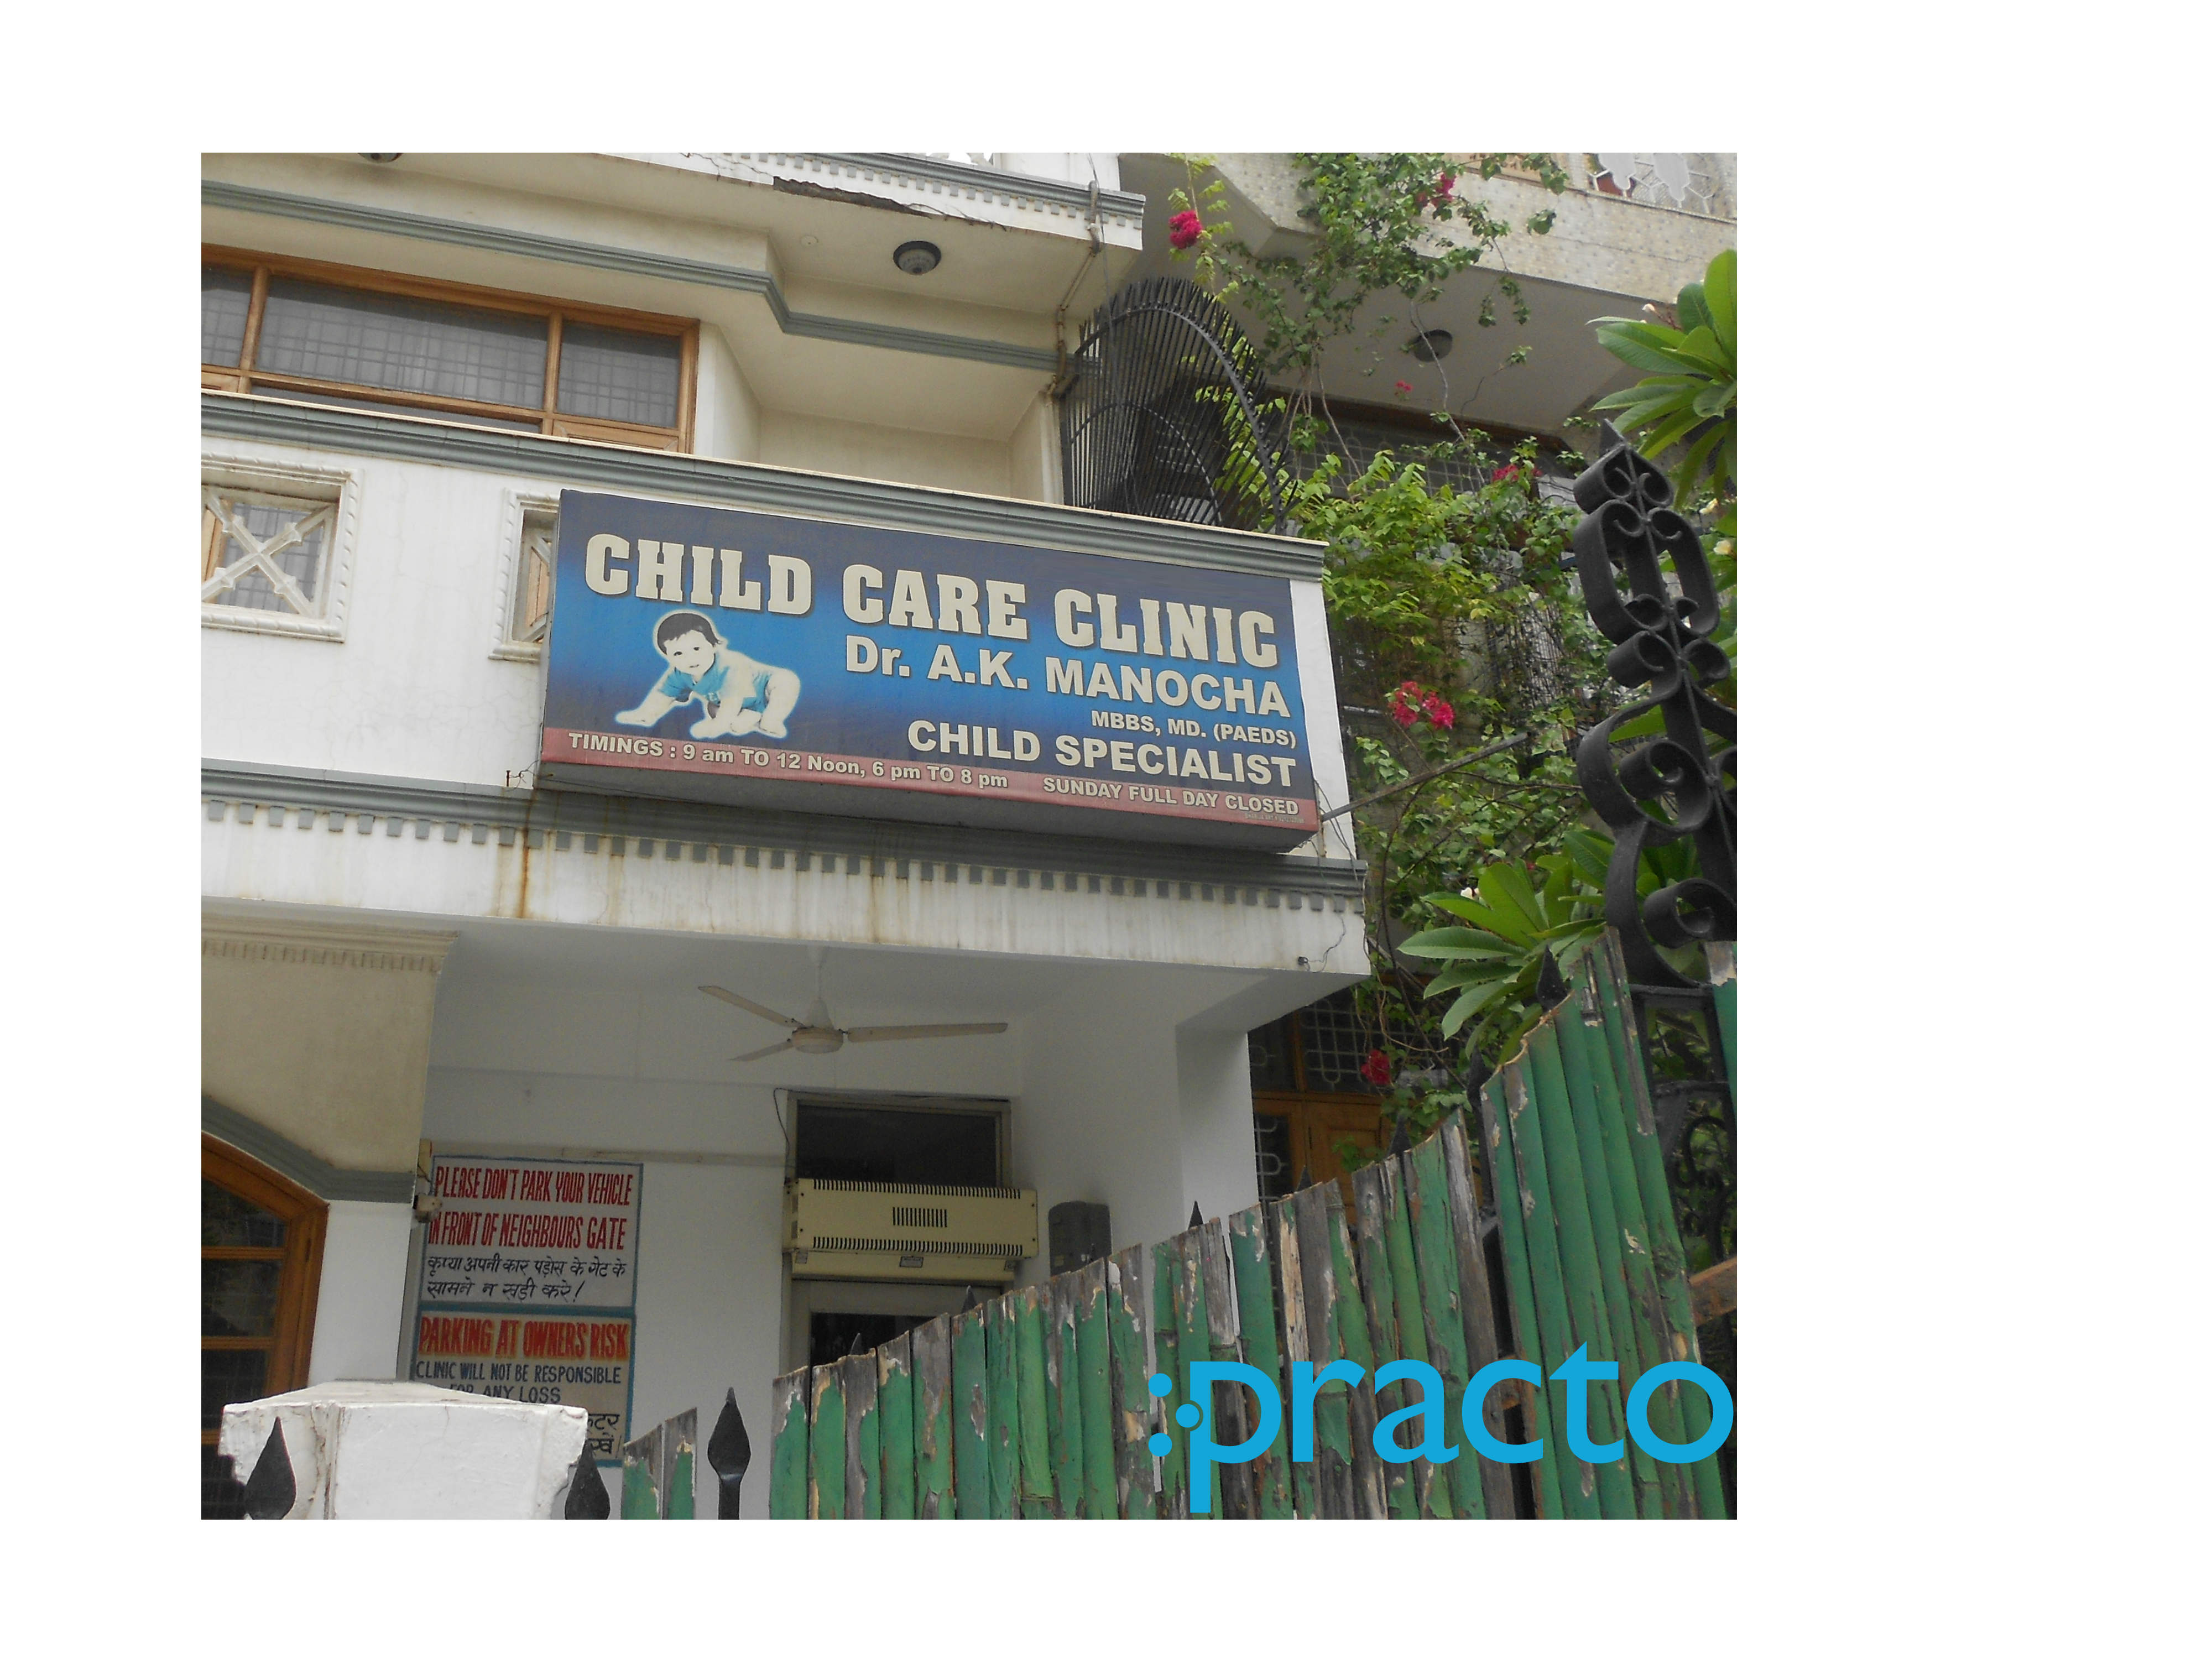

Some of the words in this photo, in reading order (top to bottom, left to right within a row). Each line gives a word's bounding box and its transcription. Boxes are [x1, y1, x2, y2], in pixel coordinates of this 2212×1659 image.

[585, 534, 812, 615] CHILD
[842, 564, 1027, 640] CARE
[1054, 588, 1278, 668] CLINIC
[846, 635, 911, 677] Dr.
[927, 644, 1028, 690] A.K.
[1045, 656, 1291, 718] MANOCHA
[1092, 710, 1160, 736] MBBS,
[1168, 718, 1206, 738] MD.
[1213, 723, 1297, 749] (PAEDS)
[568, 732, 663, 757] TIMINGS
[683, 745, 696, 760] 9
[702, 749, 734, 763] am
[741, 749, 769, 766] TO
[776, 753, 801, 769] 12
[808, 755, 865, 777] Noon,
[872, 761, 884, 777] 6
[891, 766, 920, 781] pm
[927, 765, 954, 782] TO
[962, 769, 972, 784] 8
[979, 774, 1008, 789] pm
[908, 719, 1040, 761] CHILD
[1055, 735, 1296, 787] SPECIALIST
[1044, 778, 1123, 800] SUNDAY
[1129, 785, 1177, 805] FULL
[1182, 790, 1219, 808] DAY
[1225, 795, 1298, 815] CLOSED
[435, 1166, 483, 1198] PLEASE
[482, 1168, 519, 1200] DON'T
[520, 1170, 554, 1202] PARK
[555, 1171, 584, 1203] YOUR
[588, 1173, 633, 1206] VEHICLE
[429, 1212, 442, 1244] IN
[441, 1212, 482, 1245] FRONT
[481, 1213, 499, 1246] OF
[499, 1213, 583, 1248] NEIGHBOURS
[587, 1217, 627, 1250] GATE
[464, 1253, 502, 1273] अपनी
[503, 1259, 530, 1276] कार
[570, 1257, 587, 1277] के
[588, 1255, 611, 1277] गेट
[612, 1258, 627, 1277] के
[427, 1276, 475, 1299] सामने
[482, 1282, 498, 1297] न
[419, 1317, 494, 1354] PARKING
[495, 1319, 520, 1357] AT
[589, 1323, 629, 1360] RISK
[416, 1360, 456, 1379] CLINIC
[460, 1363, 485, 1380] WILL
[491, 1363, 512, 1381] NOT
[515, 1364, 529, 1382] BE
[534, 1365, 622, 1384] RESPONSIBLE
[483, 1385, 514, 1400] ANY
[519, 1386, 561, 1404] LOSS
